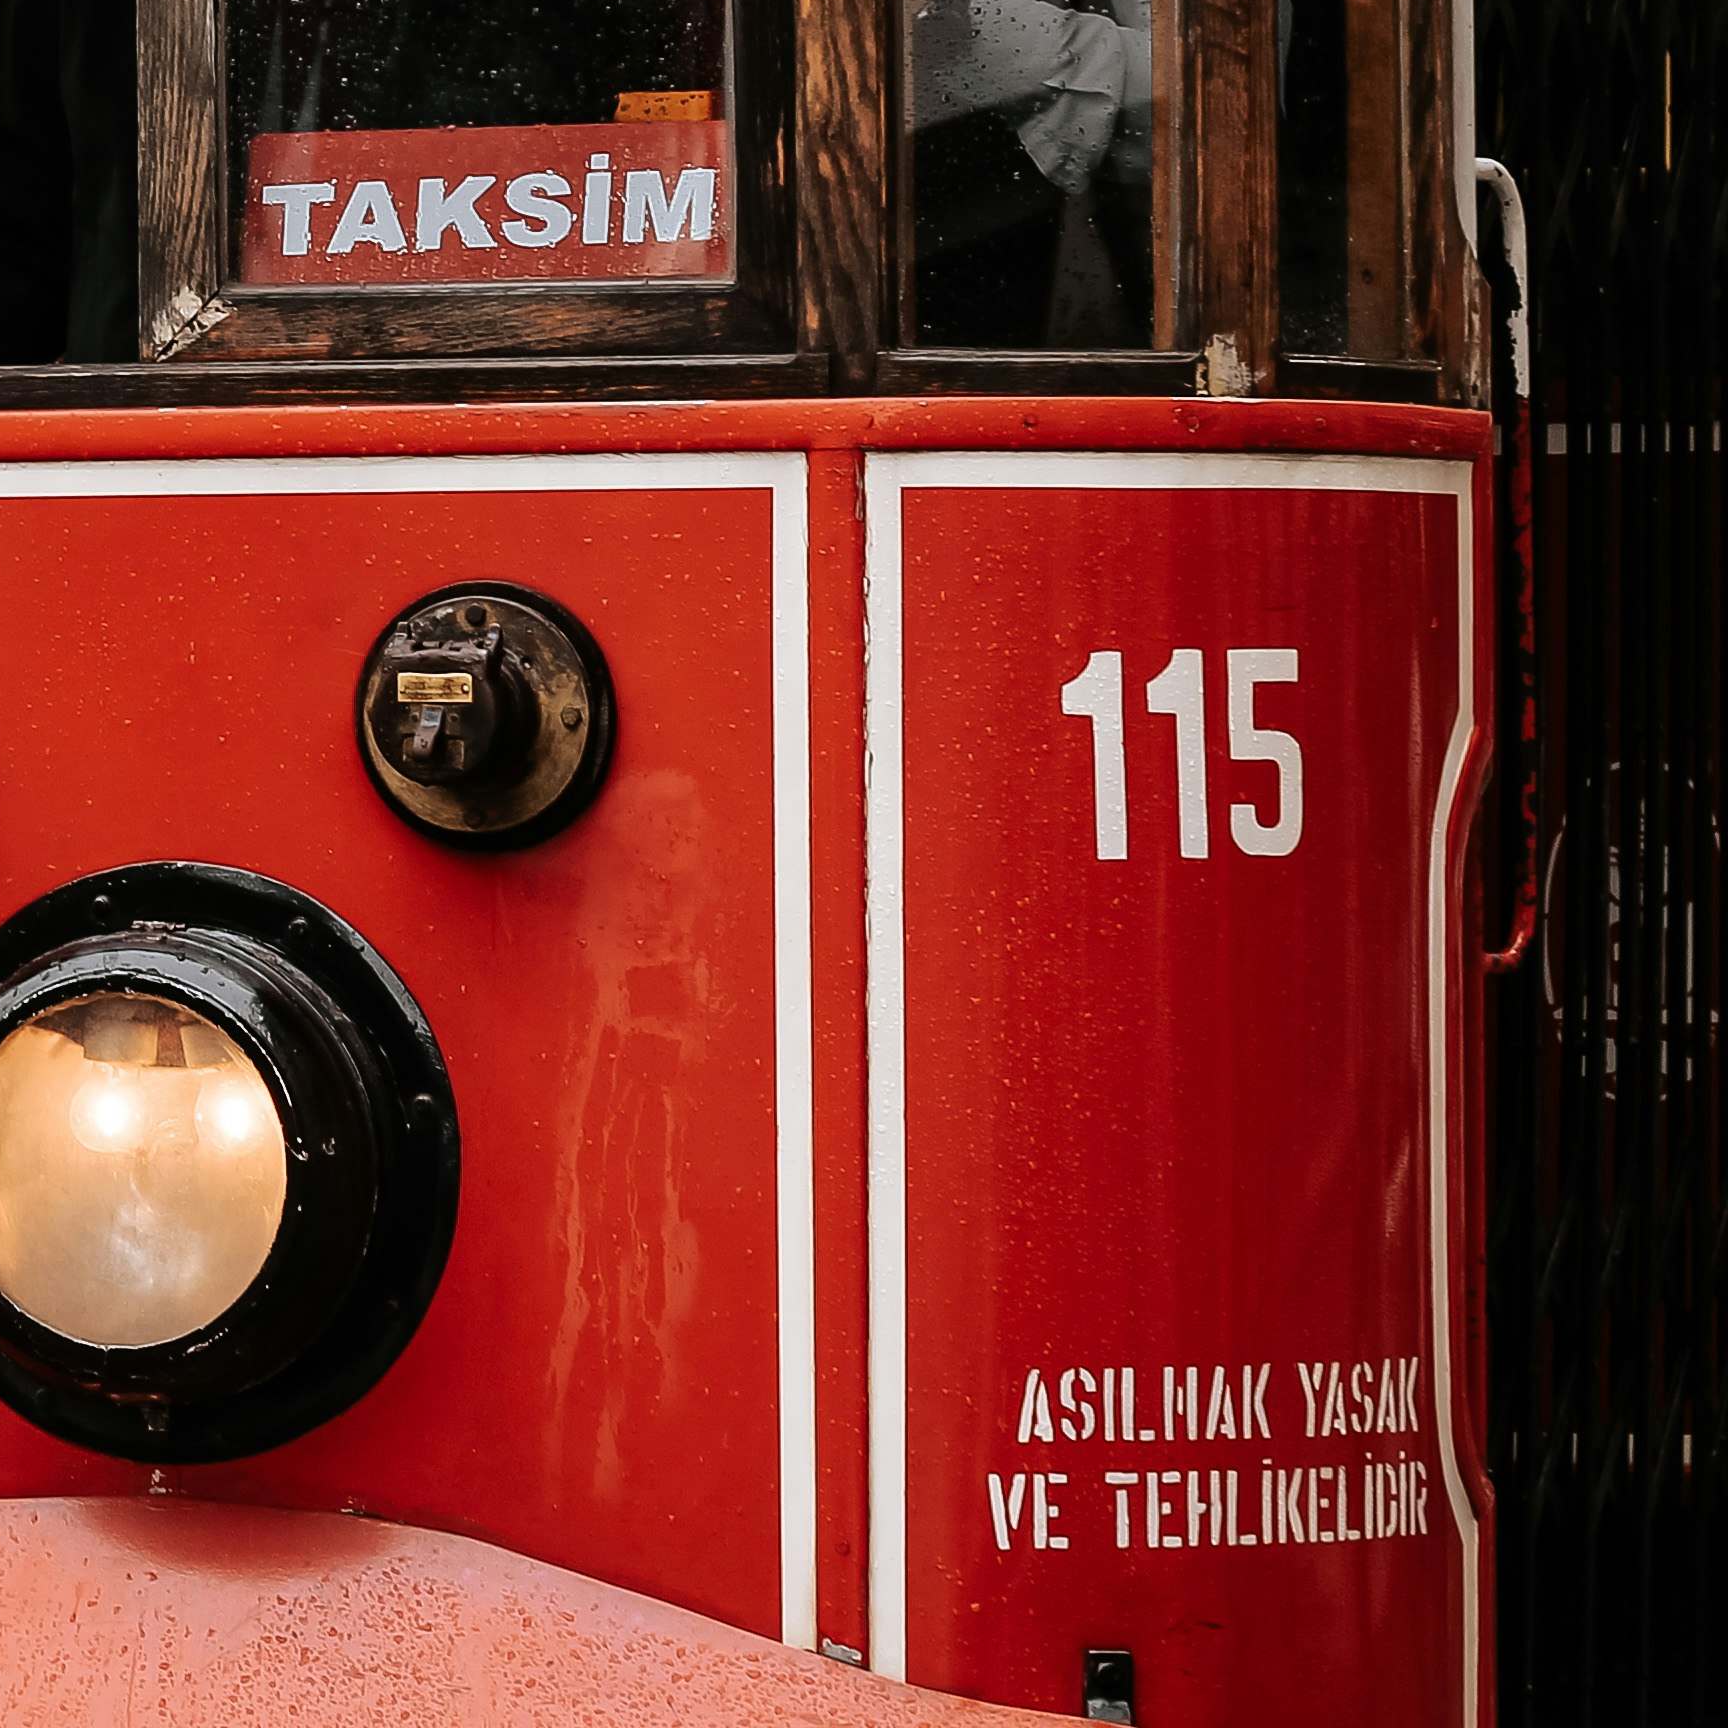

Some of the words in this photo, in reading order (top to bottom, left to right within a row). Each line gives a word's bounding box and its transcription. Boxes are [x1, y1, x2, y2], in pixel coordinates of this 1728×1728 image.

[261, 153, 719, 257] TAKSİM
[1060, 647, 1304, 861] 115
[1017, 1362, 1272, 1444] ASILMAK
[1296, 1355, 1420, 1439] YASAK
[987, 1472, 1070, 1551] VE
[1103, 1450, 1429, 1549] TEHLİKELİDİR
